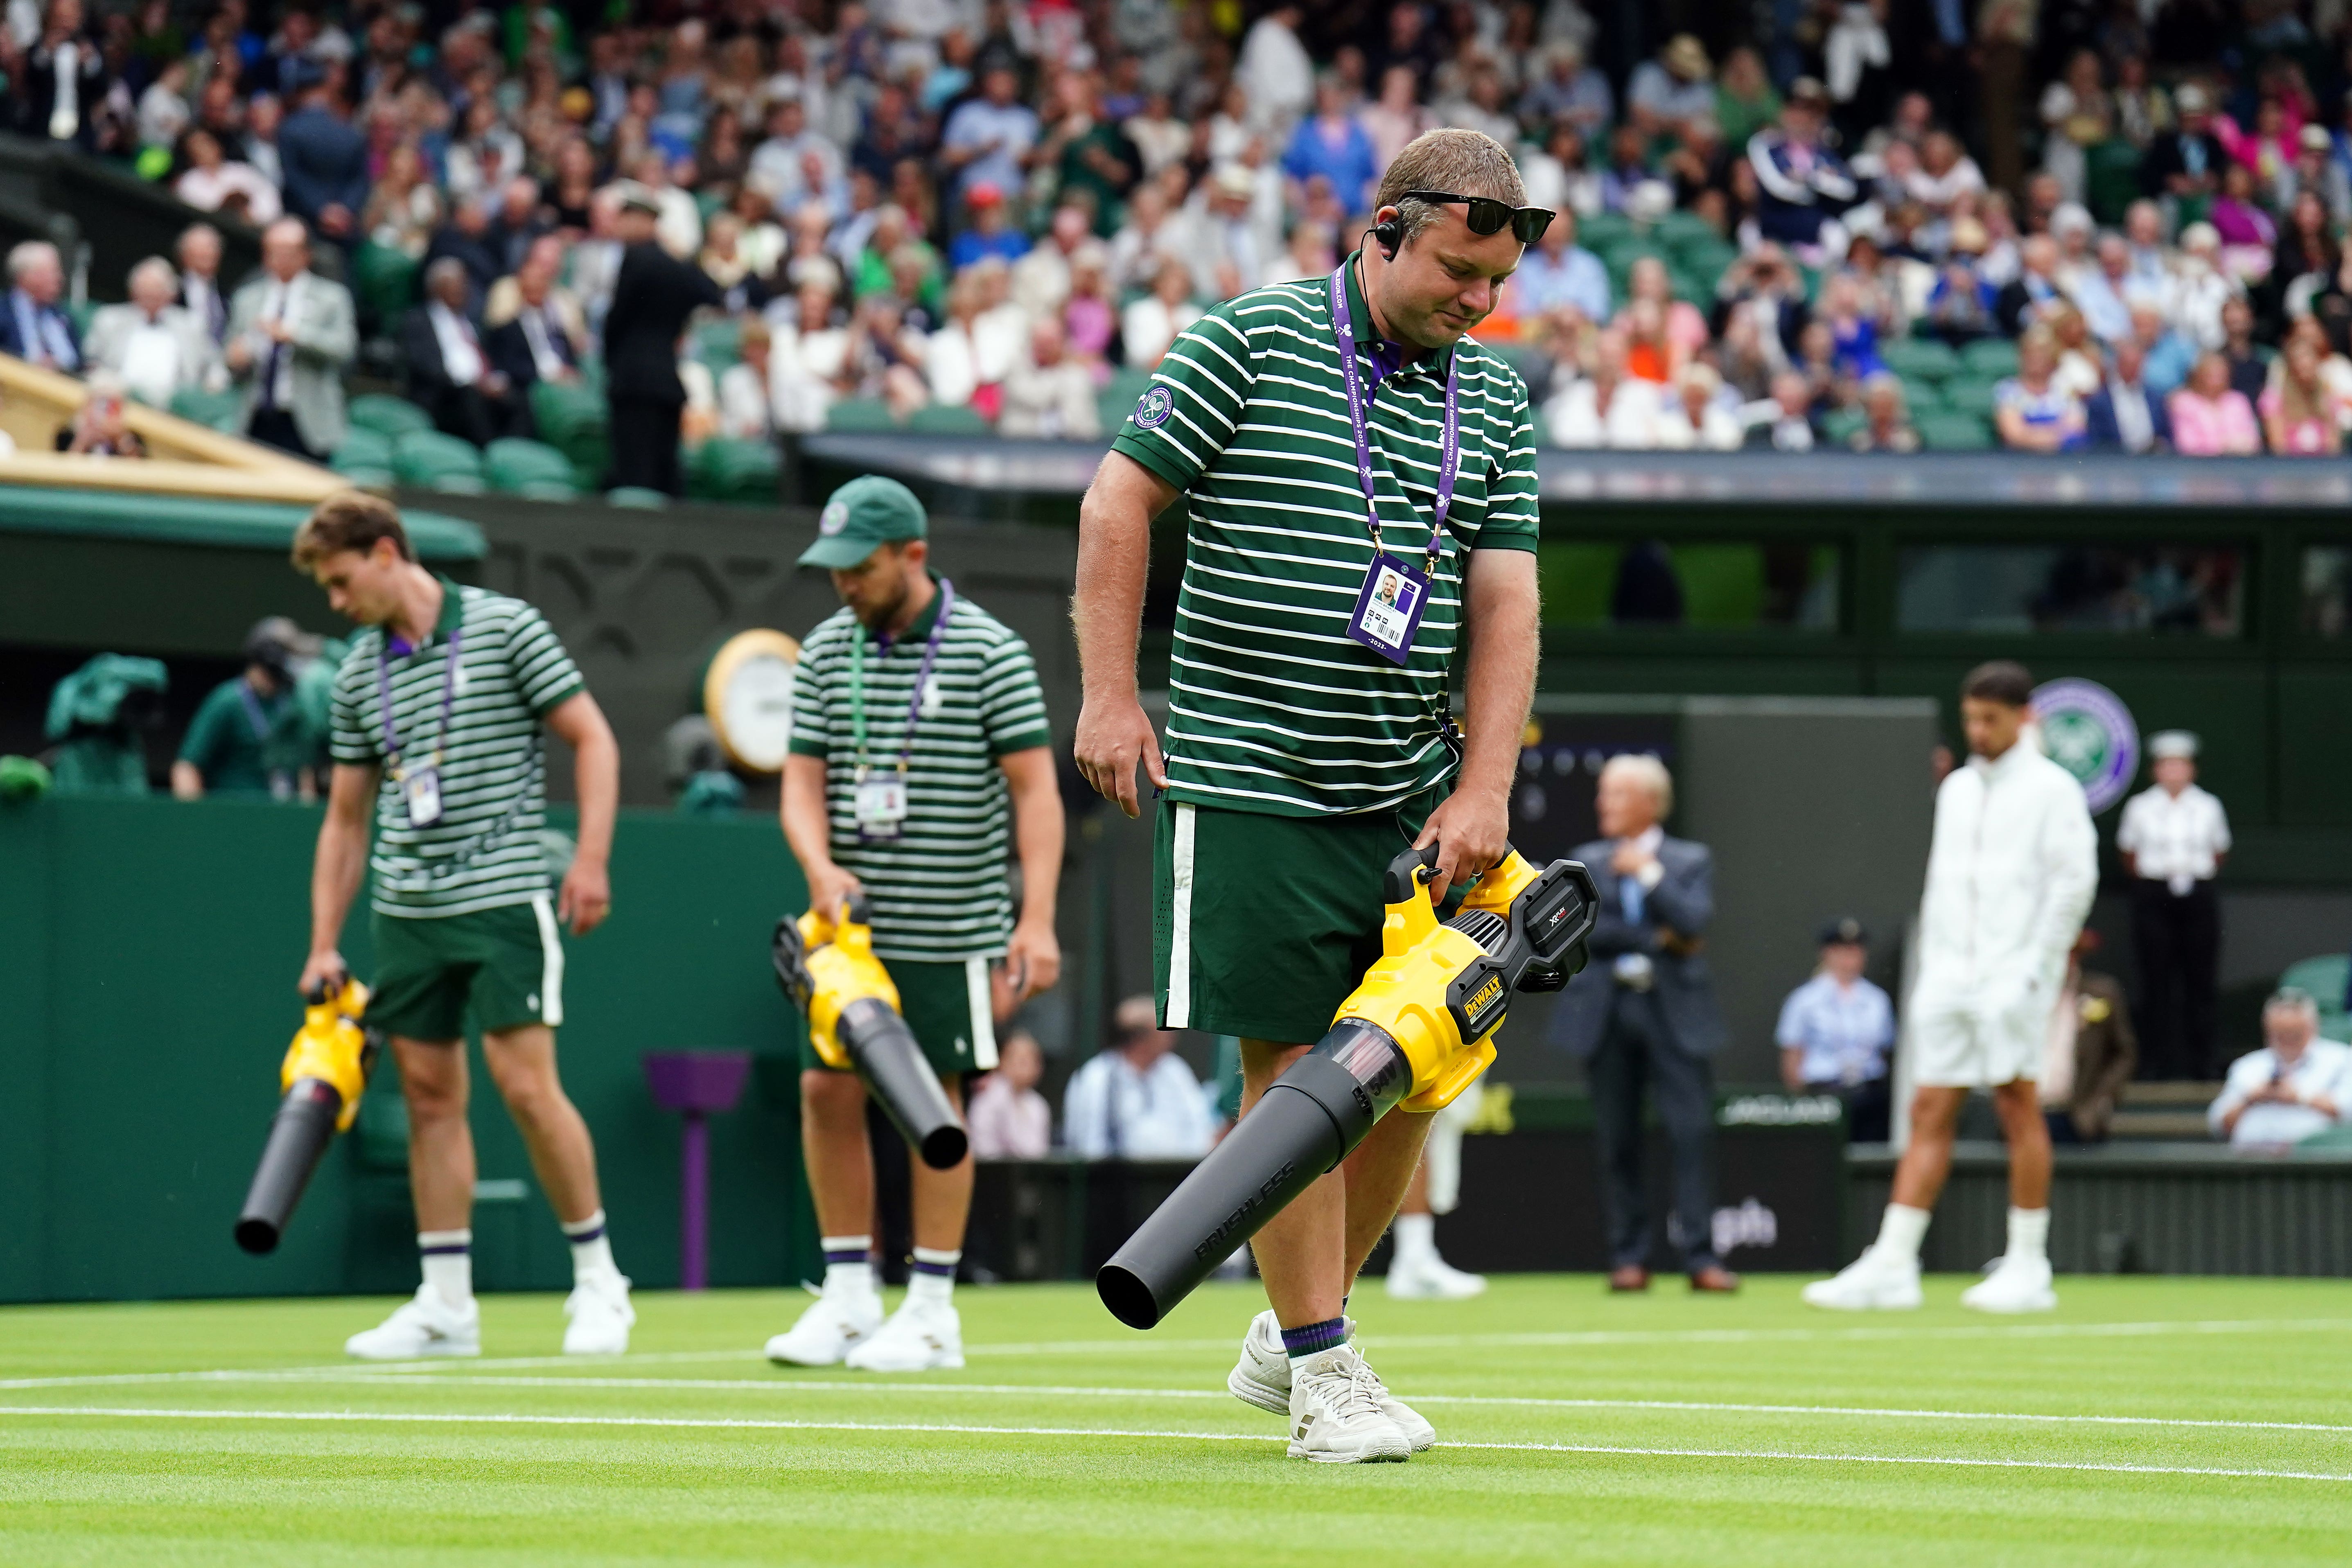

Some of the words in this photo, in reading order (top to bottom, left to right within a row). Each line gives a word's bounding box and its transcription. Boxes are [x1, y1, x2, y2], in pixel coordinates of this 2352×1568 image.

[1151, 390, 1170, 413] CHAMPIONSHIPS
[1348, 371, 1361, 428] CHAMPIONSHIPS
[1137, 413, 1158, 426] WIMBLEDON
[1549, 915, 1560, 927] XR
[1465, 977, 1500, 1017] DEWALT
[1194, 1160, 1294, 1262] BRUSHLESS
